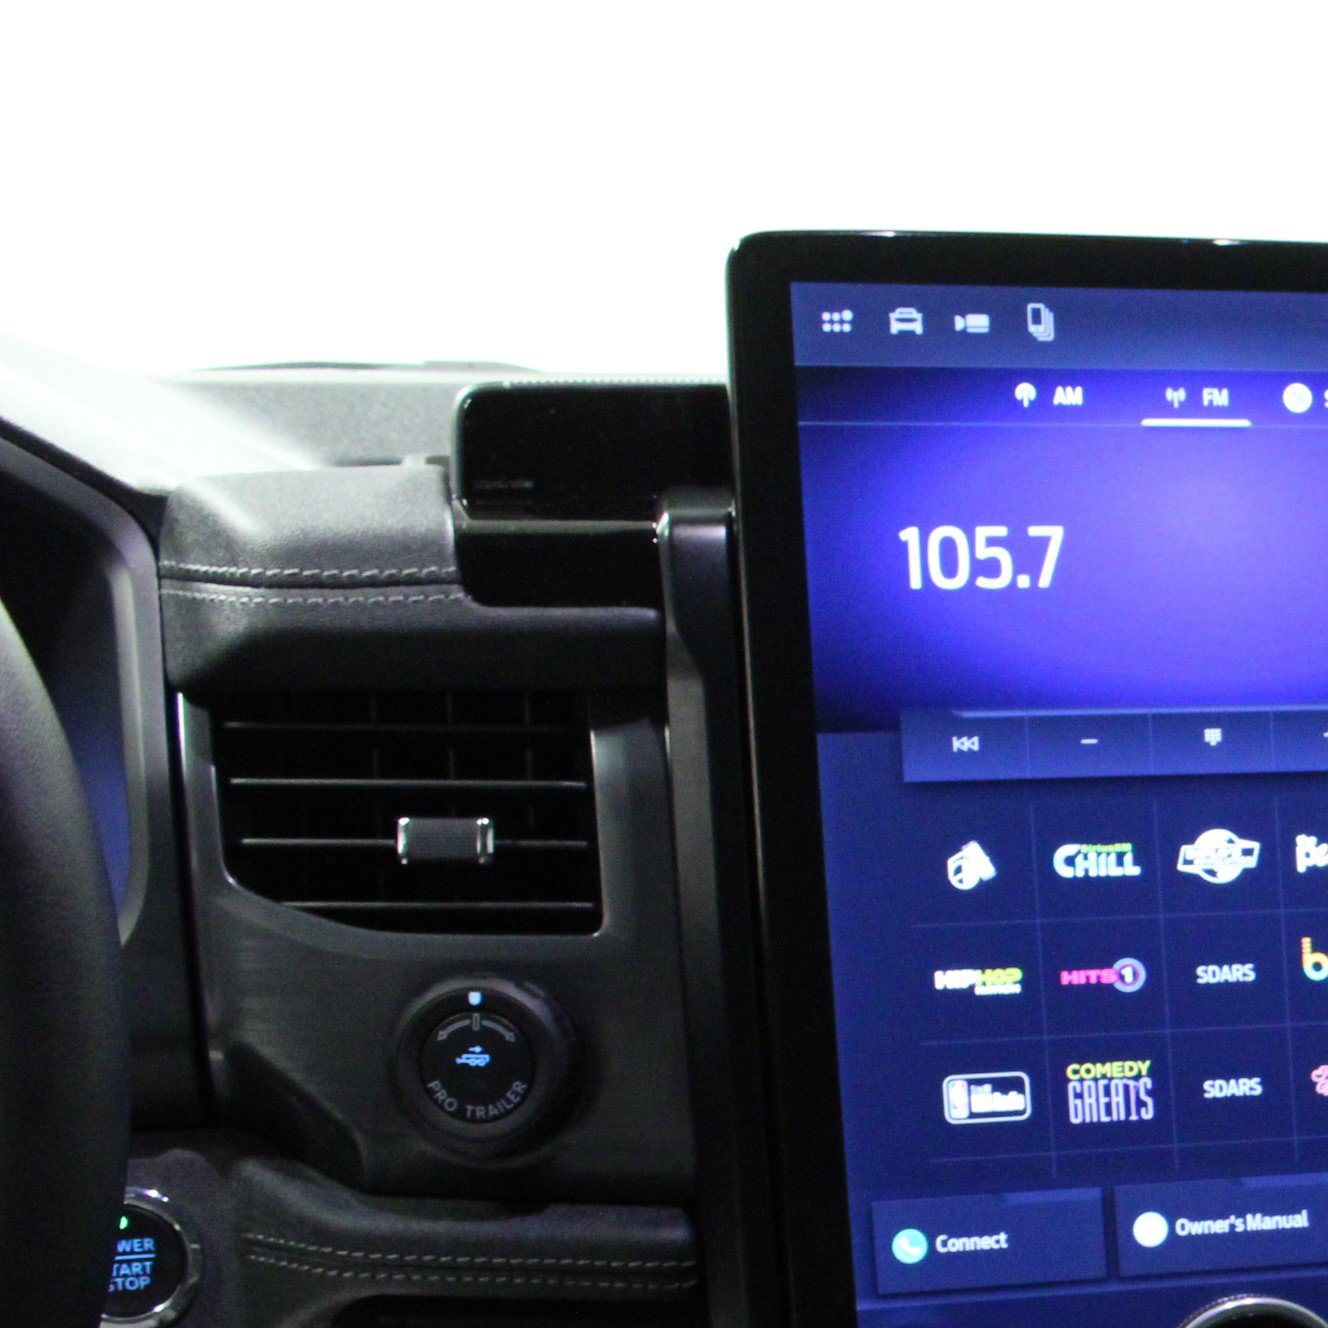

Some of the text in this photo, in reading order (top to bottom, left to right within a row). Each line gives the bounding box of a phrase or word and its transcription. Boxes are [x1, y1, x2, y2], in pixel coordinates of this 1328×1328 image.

[1053, 386, 1084, 406] AM
[1202, 388, 1229, 407] FM
[899, 525, 1065, 590] 105.7
[1059, 967, 1120, 986] HITS
[1196, 963, 1256, 984] SDARS
[1066, 1060, 1152, 1081] COMEDY
[426, 1078, 528, 1120] PRO TRAILER
[1203, 1077, 1263, 1099] SDARS
[1067, 1075, 1155, 1125] GREATS
[1175, 1209, 1310, 1237] Owner's Manual
[935, 1231, 1009, 1254] Connect
